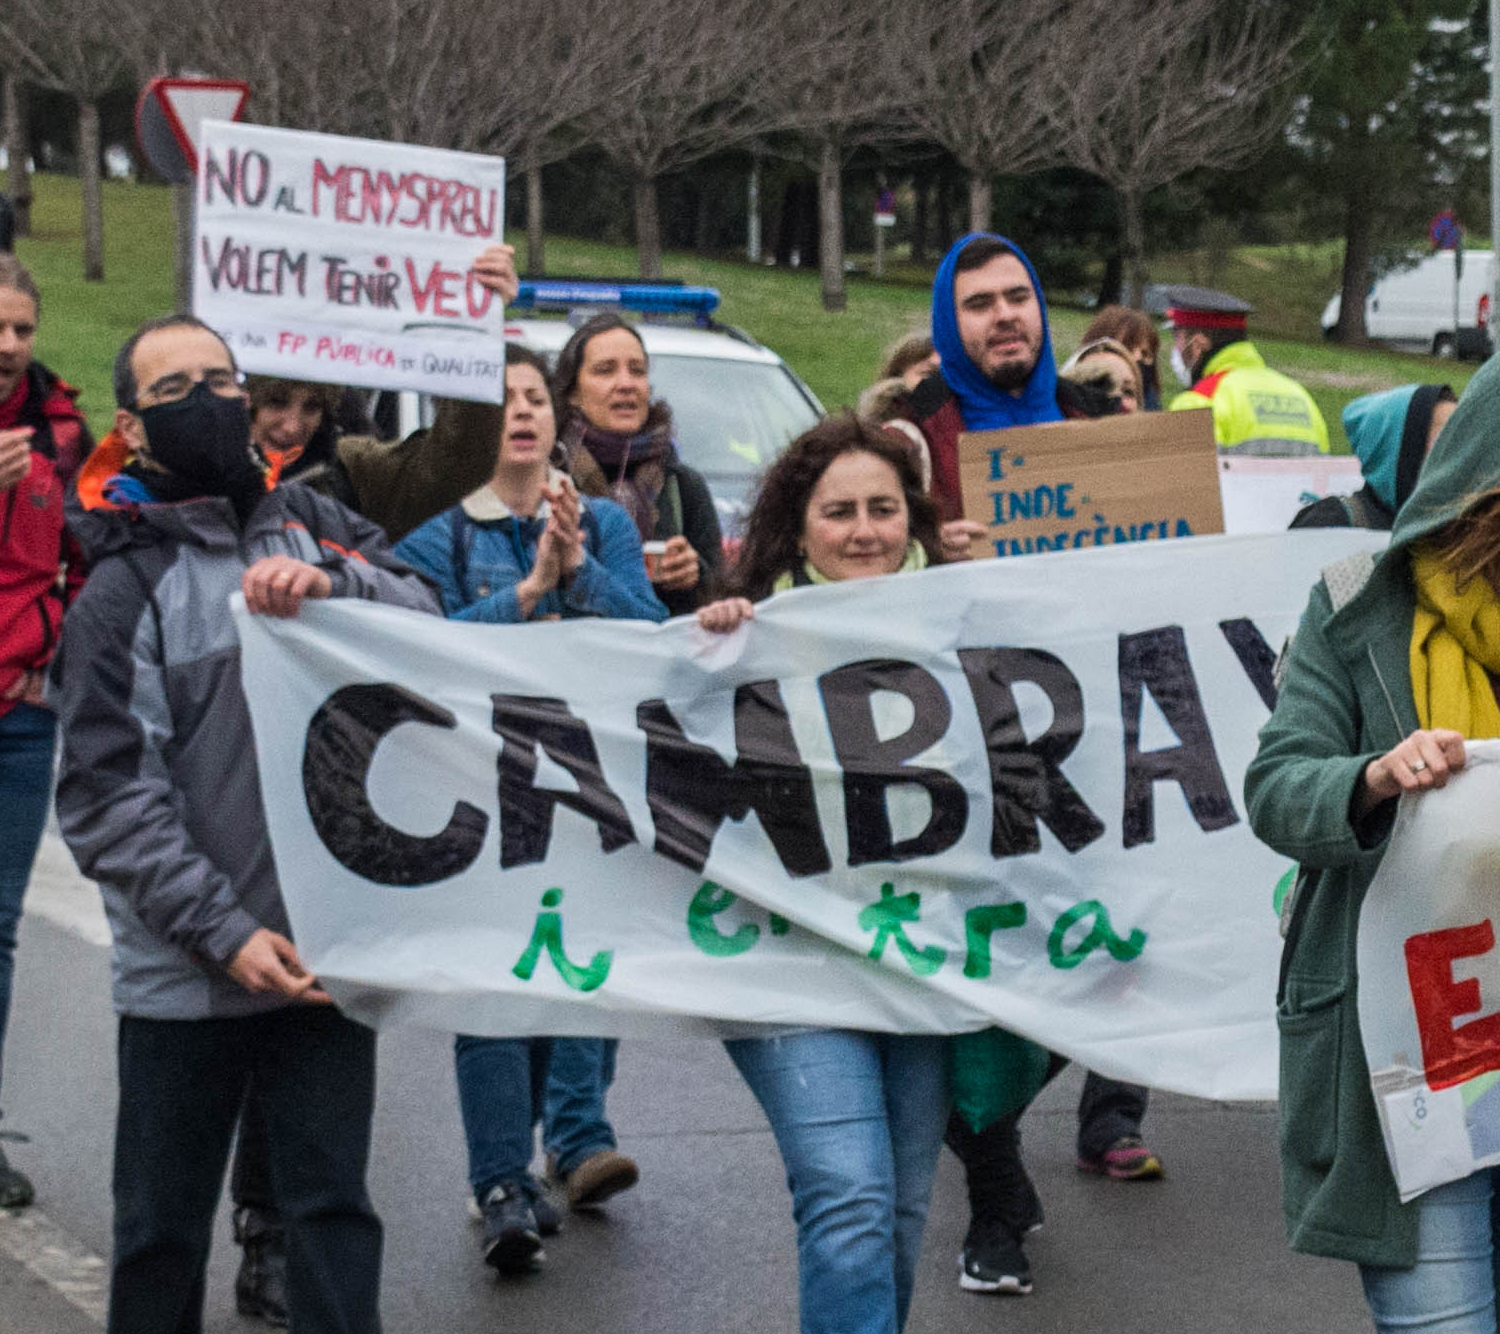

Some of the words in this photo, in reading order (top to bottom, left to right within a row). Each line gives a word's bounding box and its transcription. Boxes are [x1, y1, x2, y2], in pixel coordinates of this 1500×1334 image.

[204, 146, 271, 208] NO
[273, 185, 305, 215] AL
[201, 234, 308, 298] VOLEM
[404, 257, 493, 320] VEU
[276, 331, 308, 356] FP
[511, 887, 613, 992] i
